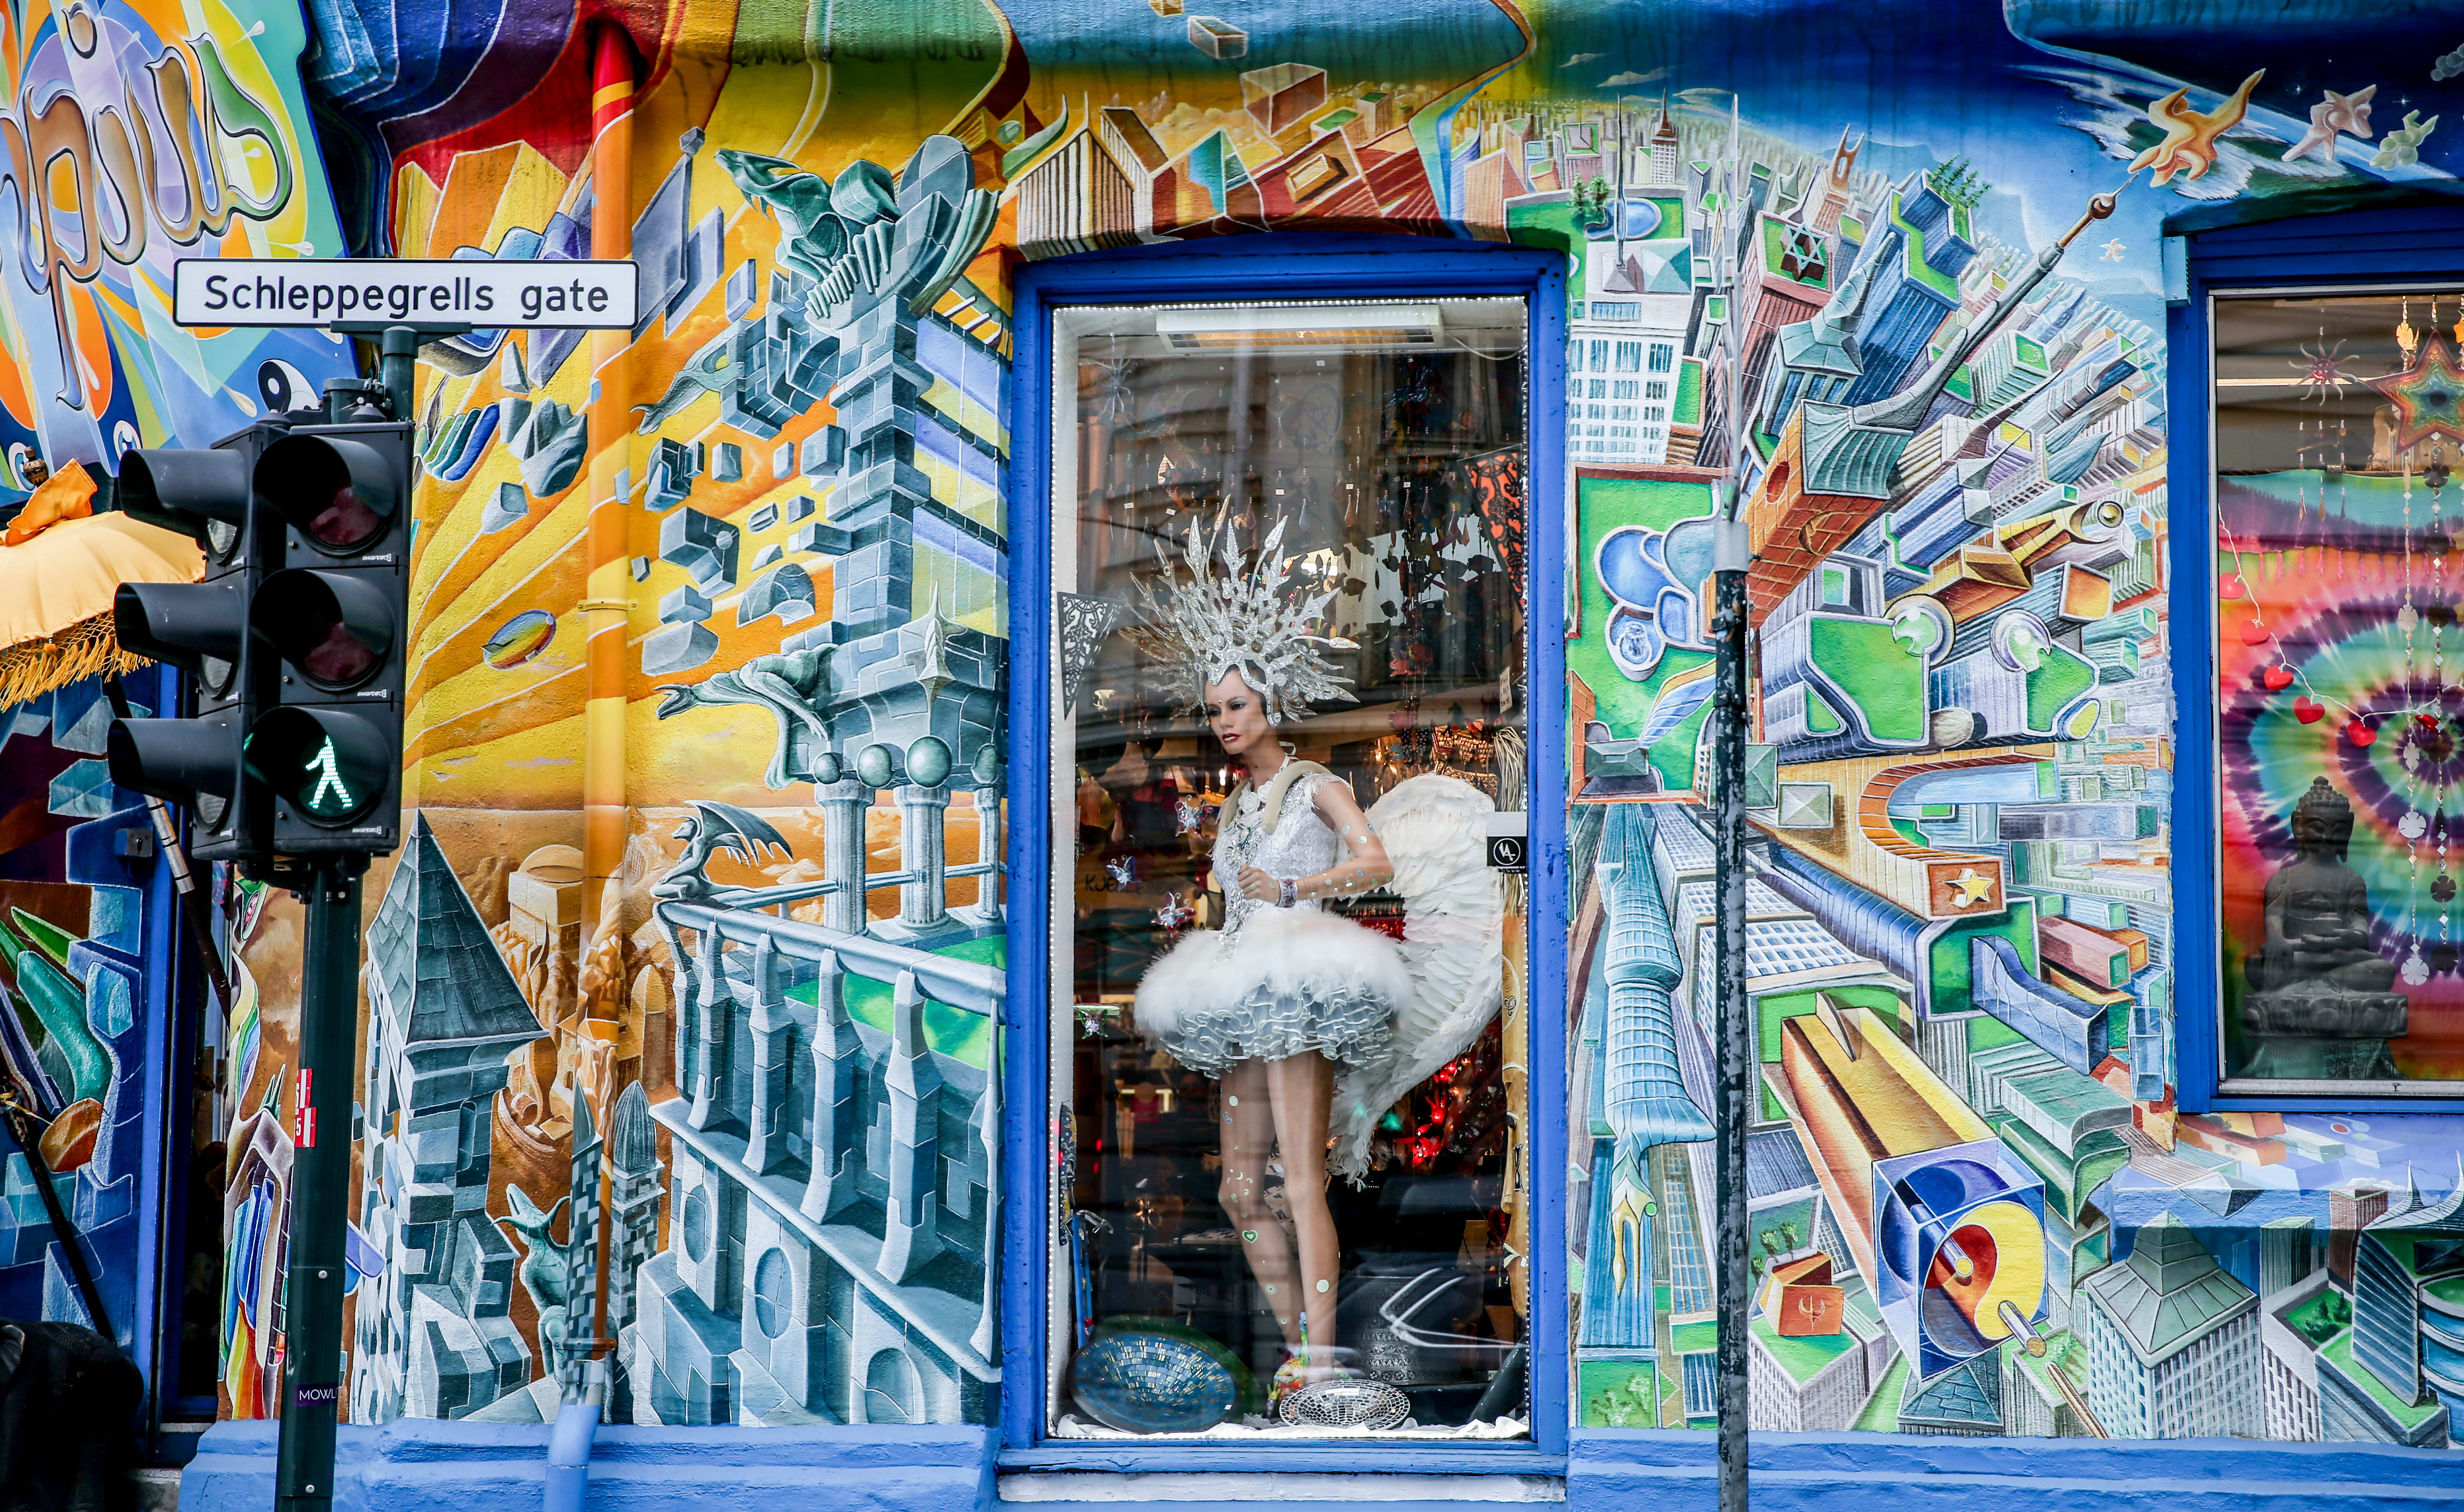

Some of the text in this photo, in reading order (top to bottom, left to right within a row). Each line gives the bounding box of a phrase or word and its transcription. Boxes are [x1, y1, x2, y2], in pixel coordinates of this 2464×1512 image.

[204, 274, 608, 319] Schleppegrells gate
[299, 1388, 337, 1401] MOWL
